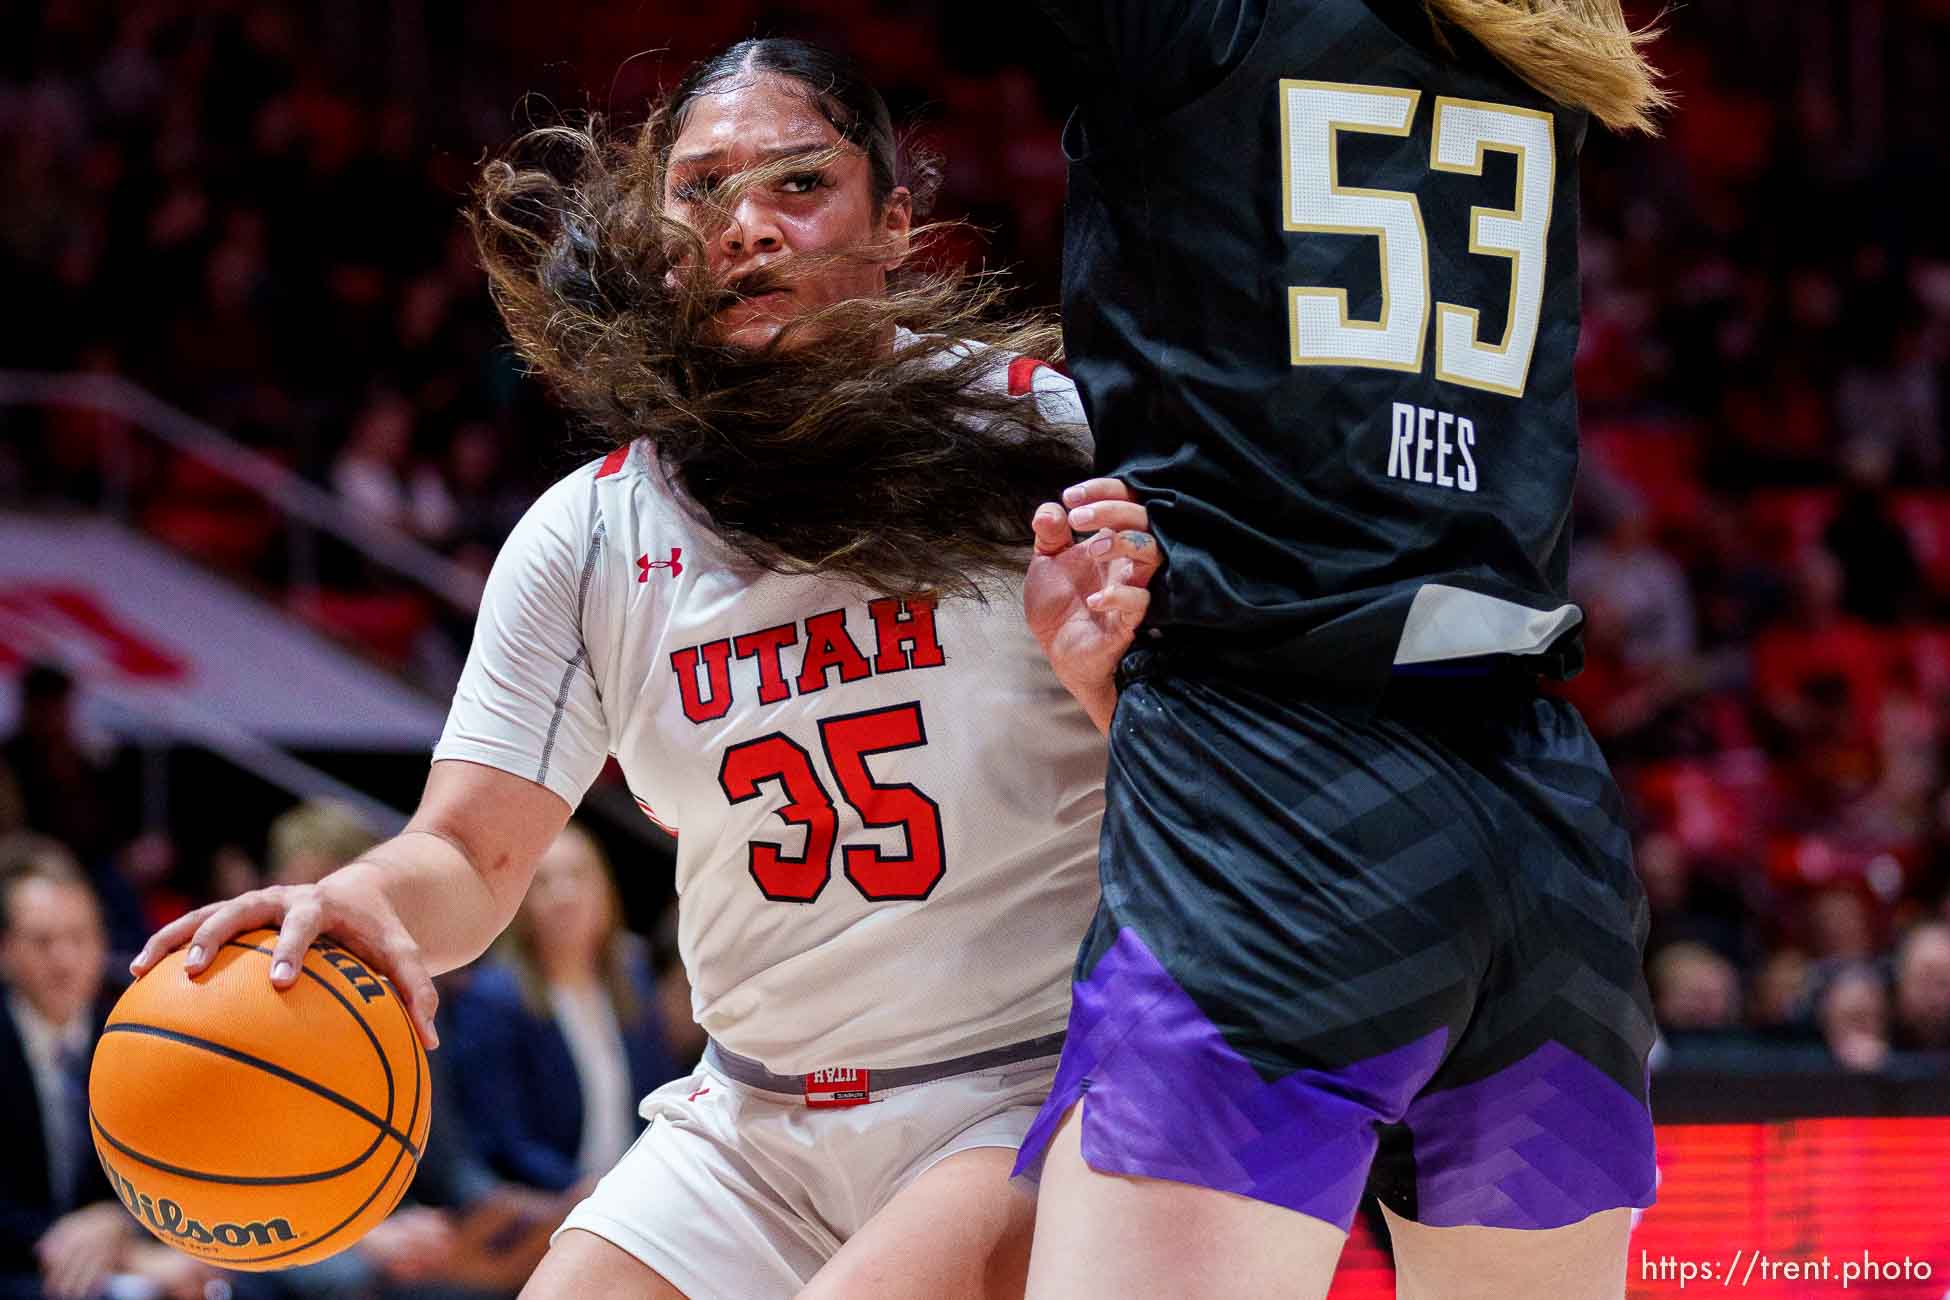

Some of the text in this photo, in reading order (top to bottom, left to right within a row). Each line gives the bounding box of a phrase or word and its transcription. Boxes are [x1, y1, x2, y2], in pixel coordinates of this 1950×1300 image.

[1279, 78, 1556, 398] 53
[1387, 402, 1477, 491] REES
[670, 593, 946, 725] UTAH
[718, 700, 947, 904] 35
